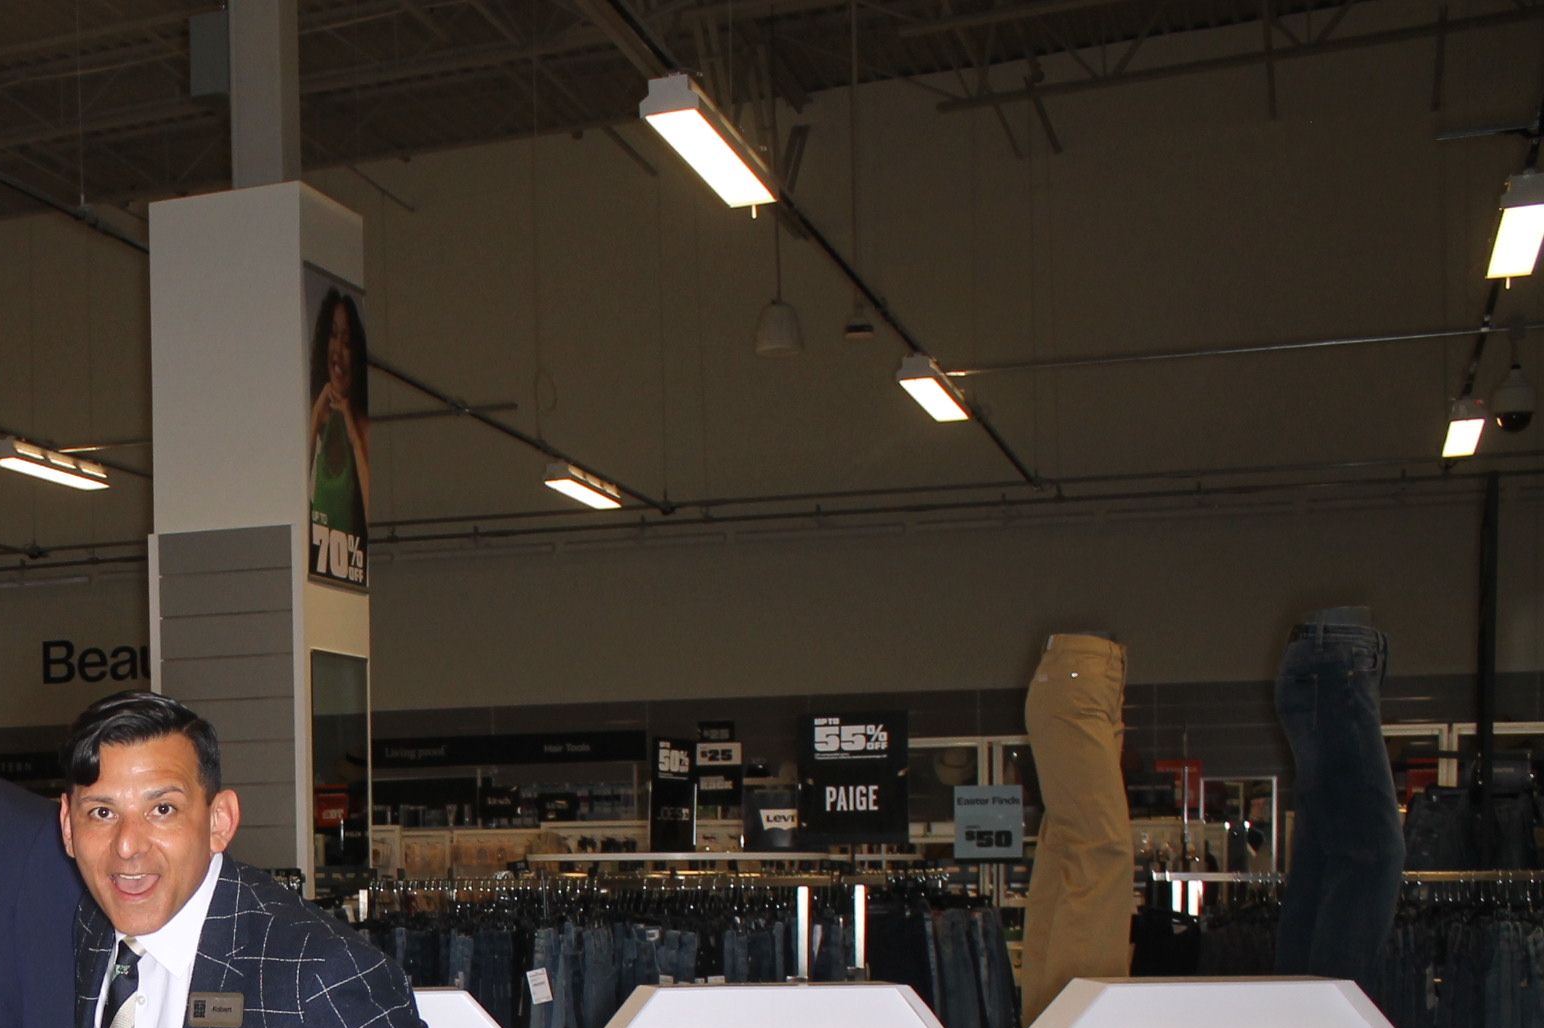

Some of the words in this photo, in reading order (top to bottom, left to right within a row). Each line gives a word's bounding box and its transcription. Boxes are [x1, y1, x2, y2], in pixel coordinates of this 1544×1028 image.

[312, 523, 364, 579] 70%
[349, 566, 364, 583] OFF
[814, 724, 888, 751] 55%
[866, 742, 888, 750] OFF
[565, 742, 591, 752] Tools
[700, 750, 733, 762] $25
[825, 785, 879, 811] PAIGE
[957, 797, 989, 805] Easter
[992, 796, 1020, 805] Finds
[965, 830, 1013, 848] $50
